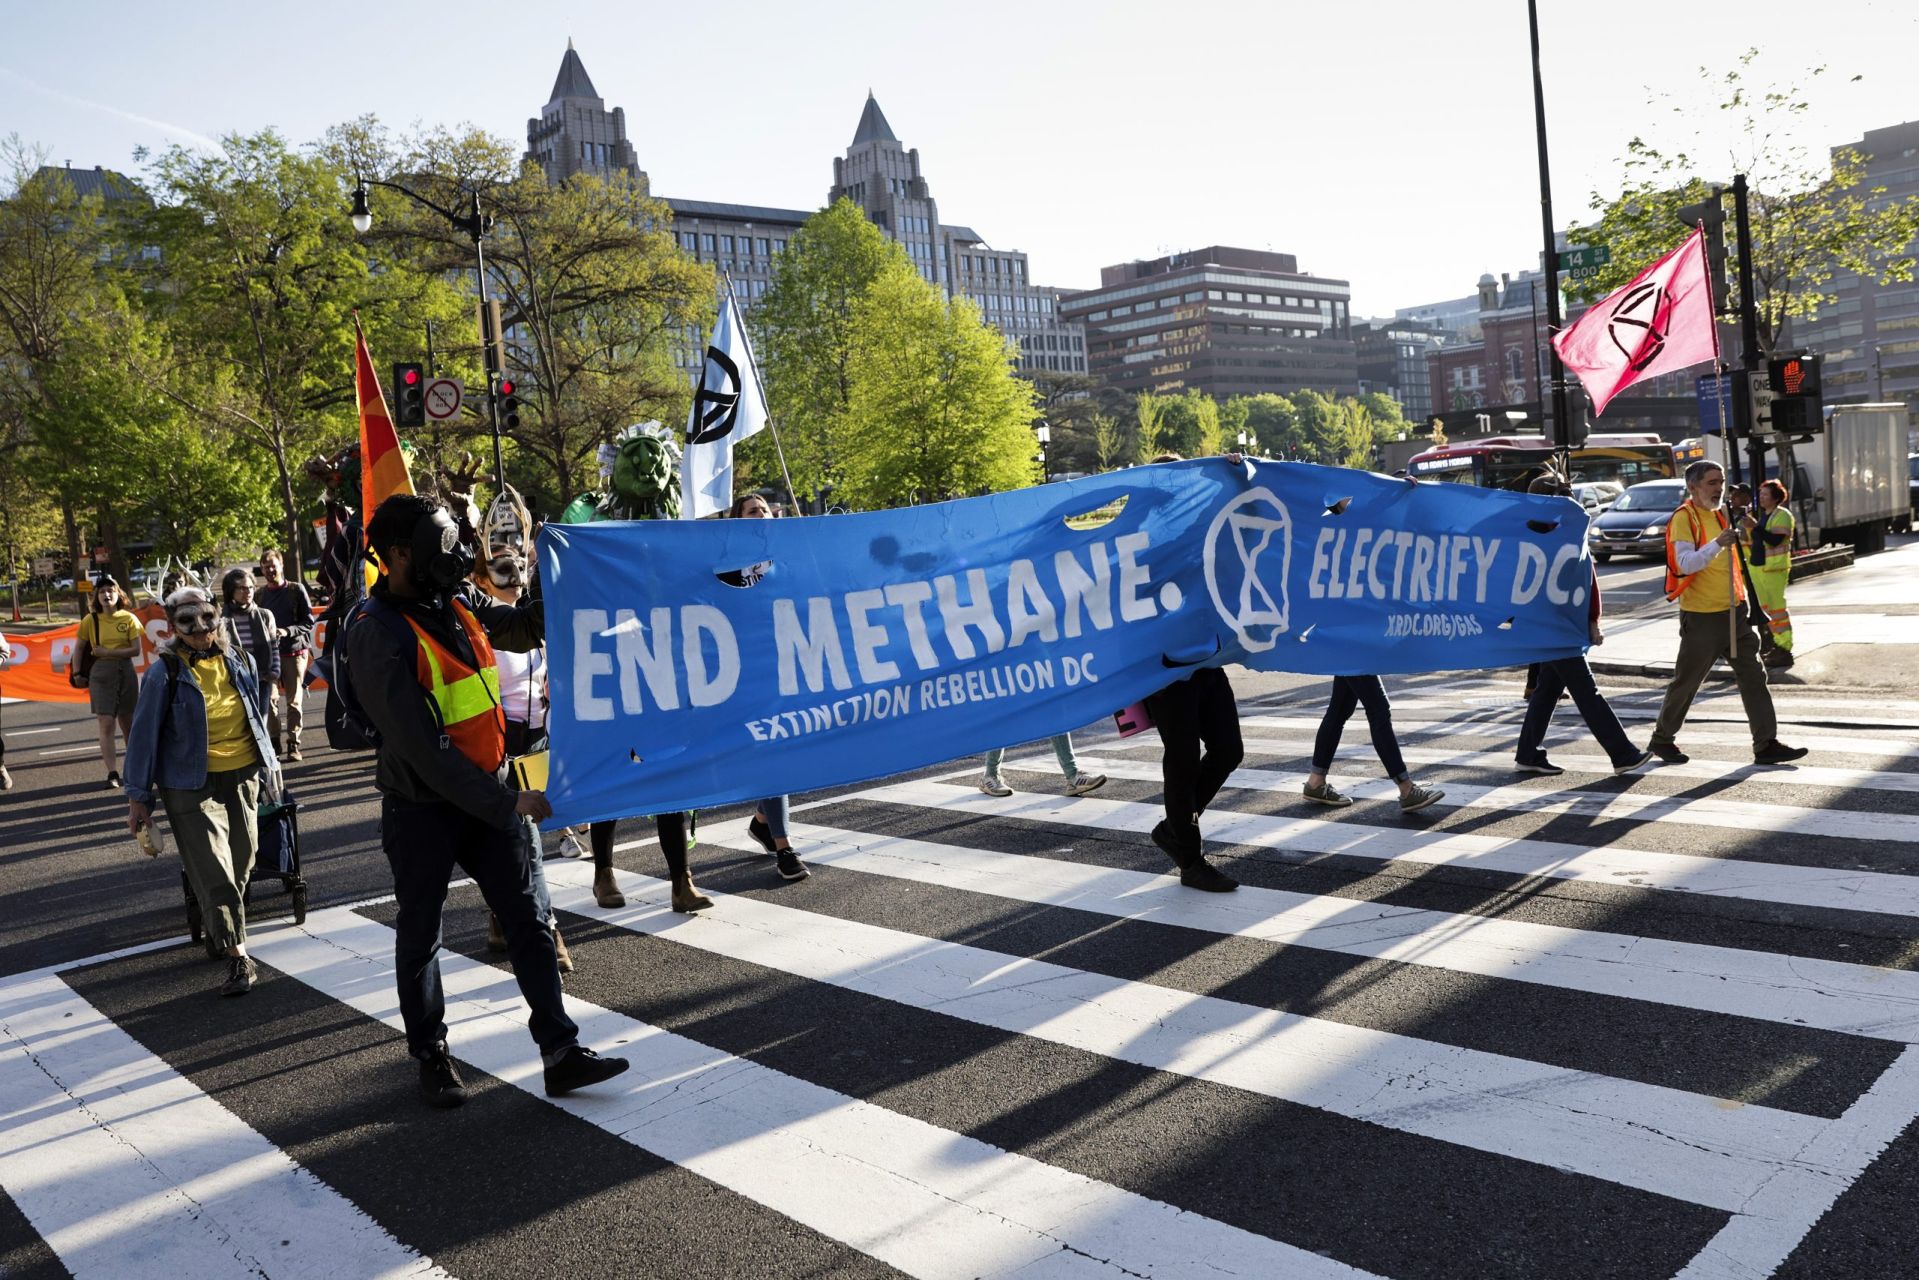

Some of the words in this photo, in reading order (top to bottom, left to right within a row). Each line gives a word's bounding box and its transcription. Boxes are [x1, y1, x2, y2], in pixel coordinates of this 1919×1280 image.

[1566, 252, 1583, 266] 14
[1573, 266, 1597, 278] 800
[1753, 379, 1770, 391] ONE
[1754, 395, 1771, 408] WAY
[1309, 527, 1501, 603] ELECTRIFY
[1510, 541, 1586, 607] DC.
[573, 604, 741, 721] END
[773, 531, 1183, 696] METHANE.
[1384, 613, 1483, 640] XRDC.ORG/GAS
[745, 685, 911, 741] EXTINCTION
[920, 659, 1054, 711] REBELLION
[1062, 653, 1098, 687] DC
